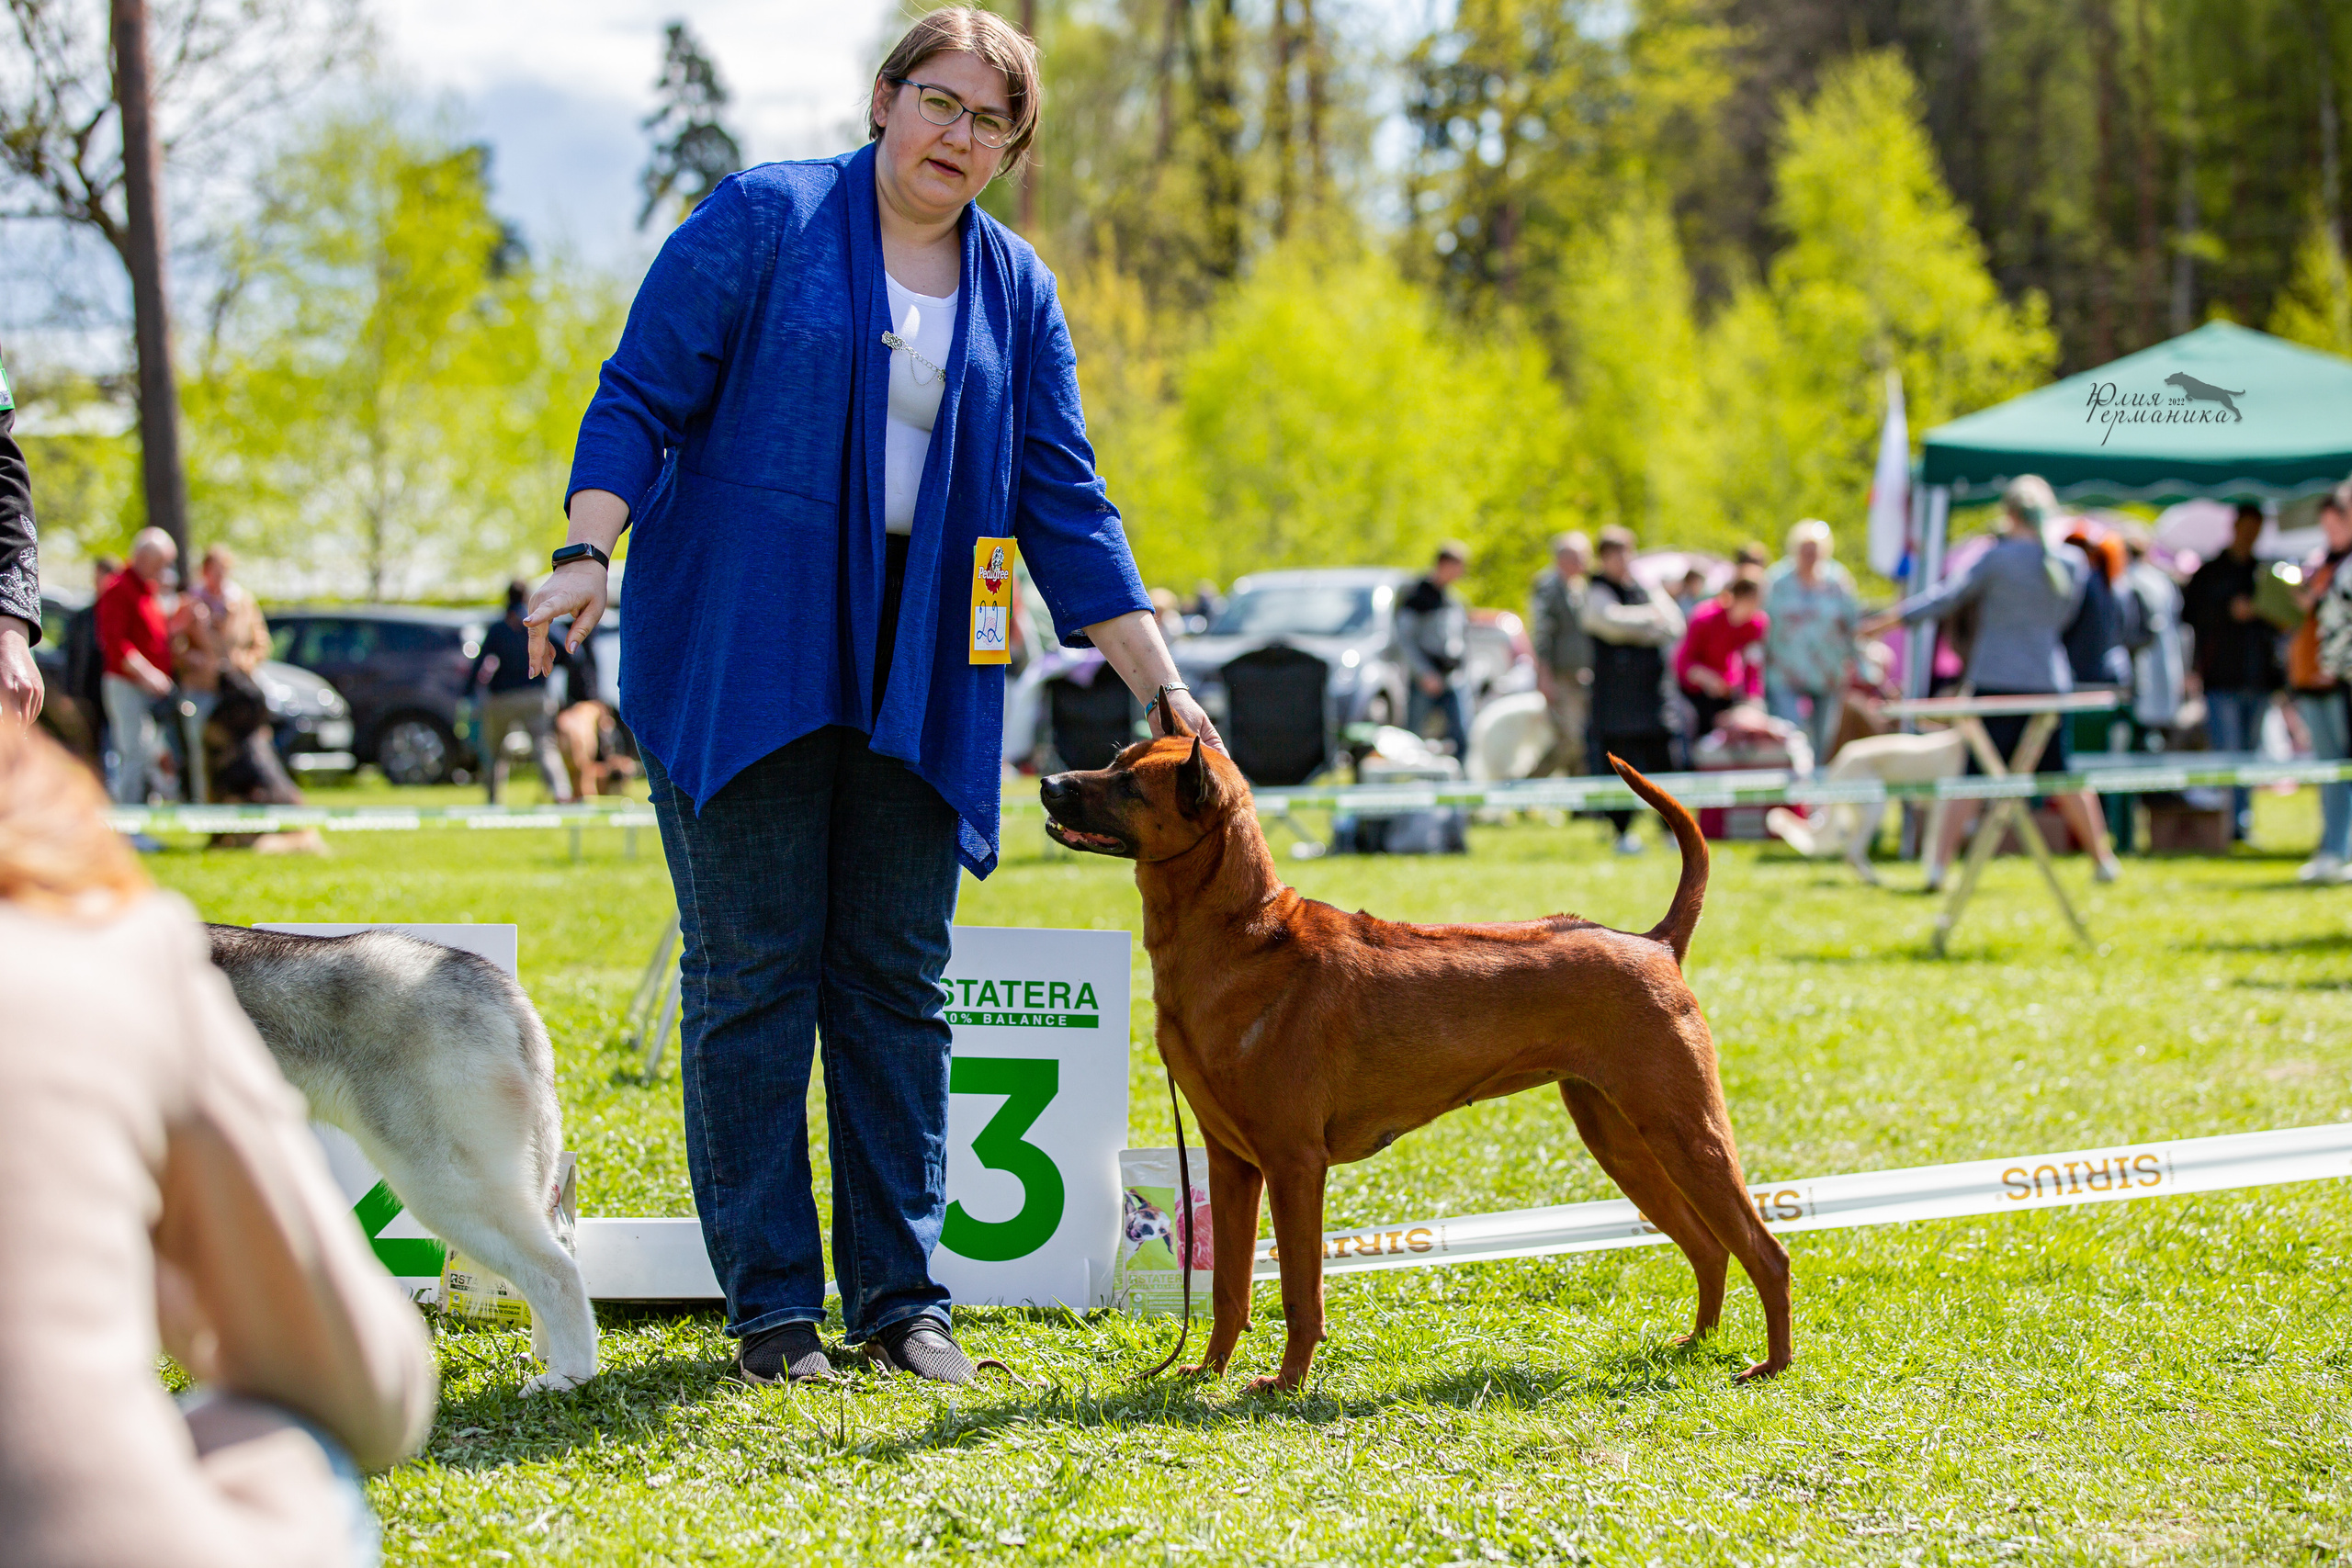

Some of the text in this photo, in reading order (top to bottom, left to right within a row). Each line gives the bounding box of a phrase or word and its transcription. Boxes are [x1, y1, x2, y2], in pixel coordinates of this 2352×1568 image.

[978, 566, 1009, 582] Pedigree
[976, 600, 1004, 643] 22
[983, 1013, 1068, 1026] BALANCE
[938, 1056, 1065, 1262] 3
[2002, 1154, 2162, 1201] SIRIUS
[1138, 1274, 1183, 1283] STATER
